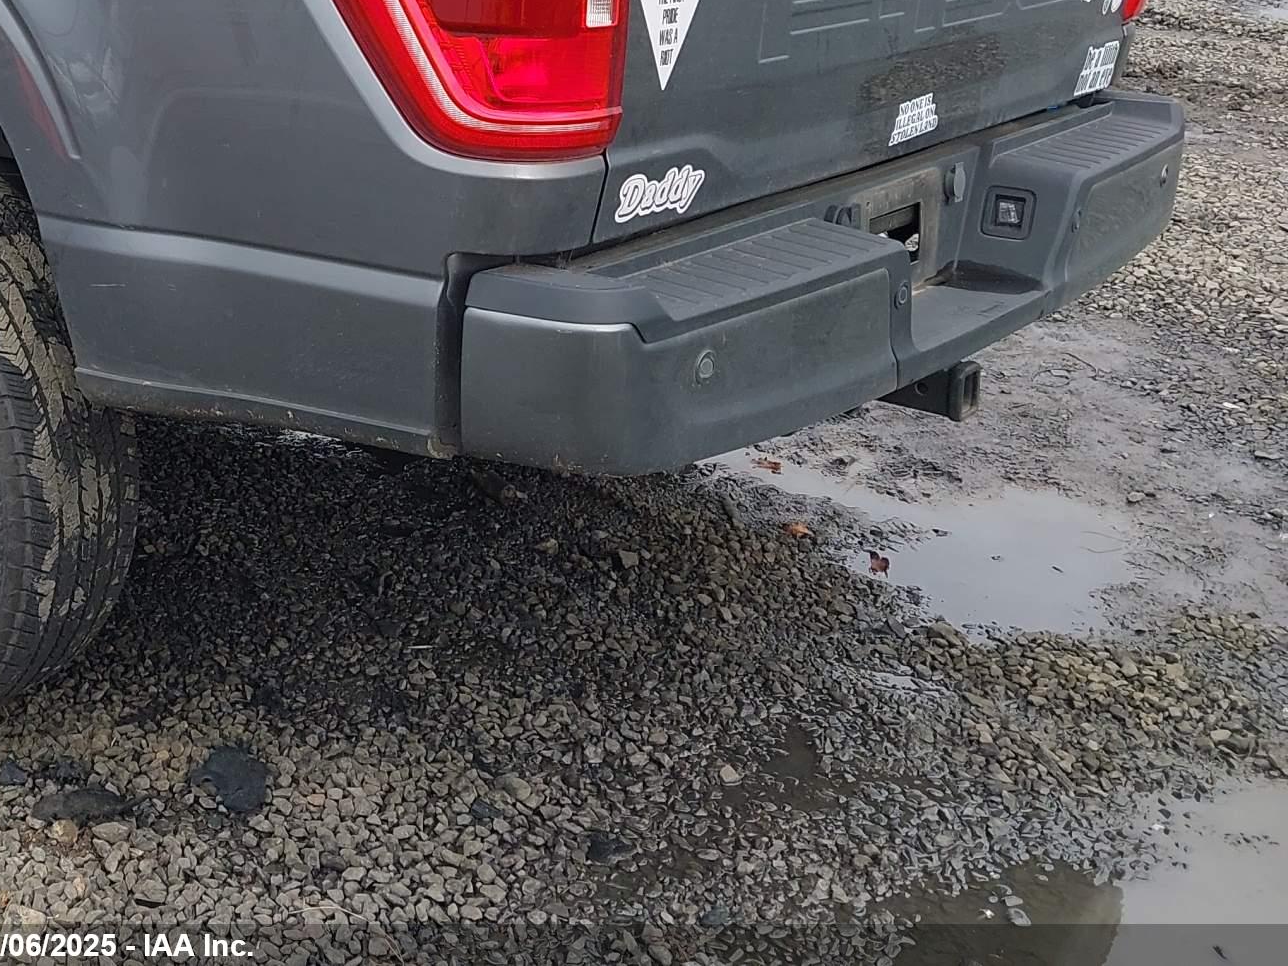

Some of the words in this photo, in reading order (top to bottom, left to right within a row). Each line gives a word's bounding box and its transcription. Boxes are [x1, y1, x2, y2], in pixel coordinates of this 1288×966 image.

[662, 7, 679, 25] PRIDE
[659, 28, 673, 46] WAS
[659, 49, 674, 66] RIOT
[900, 103, 910, 116] NO
[911, 97, 925, 113] ONE
[924, 95, 932, 107] IS
[896, 109, 925, 130] ILLEGAL
[925, 105, 935, 118] ON
[891, 125, 919, 143] STOLEN
[918, 117, 937, 133] LAND
[617, 167, 703, 218] Daddy
